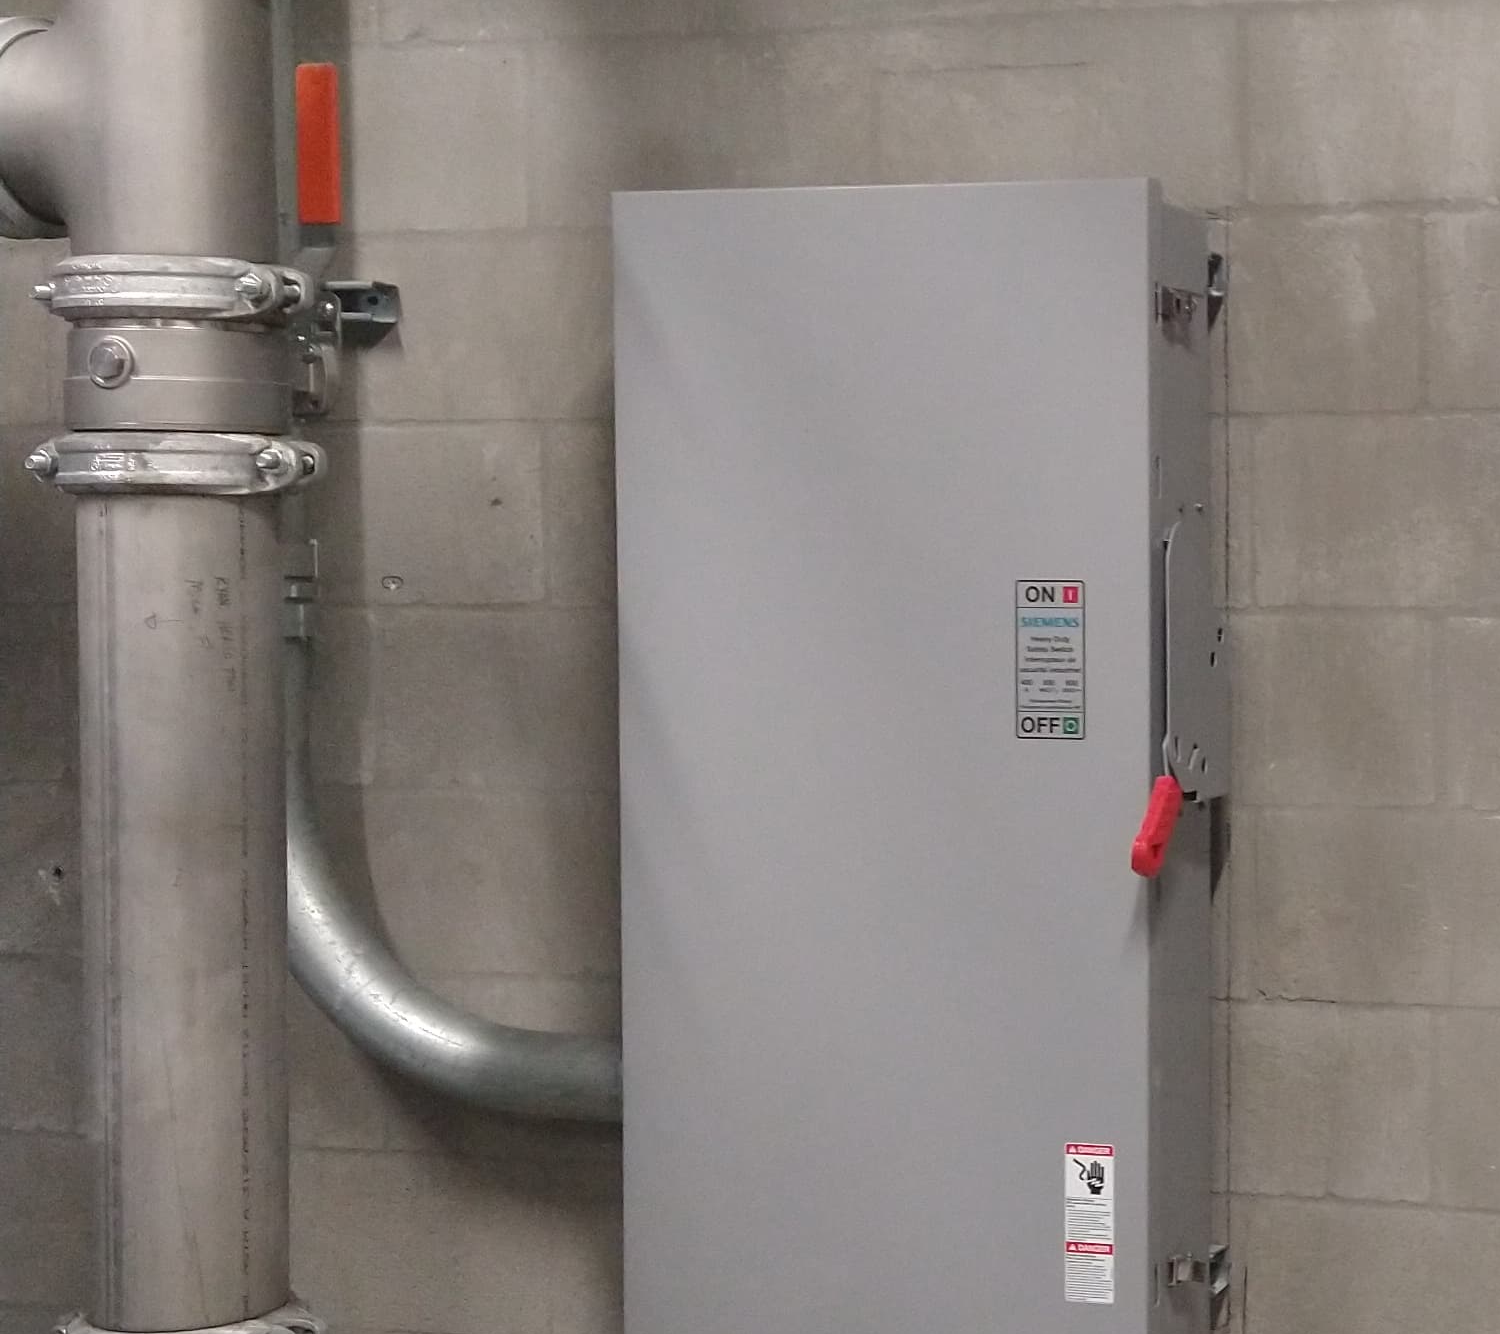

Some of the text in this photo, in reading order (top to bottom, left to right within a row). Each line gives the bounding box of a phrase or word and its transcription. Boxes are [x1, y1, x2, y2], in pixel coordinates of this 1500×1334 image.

[1025, 585, 1055, 603] ON
[1020, 617, 1080, 628] SIEMENS
[1021, 716, 1060, 734] OFF
